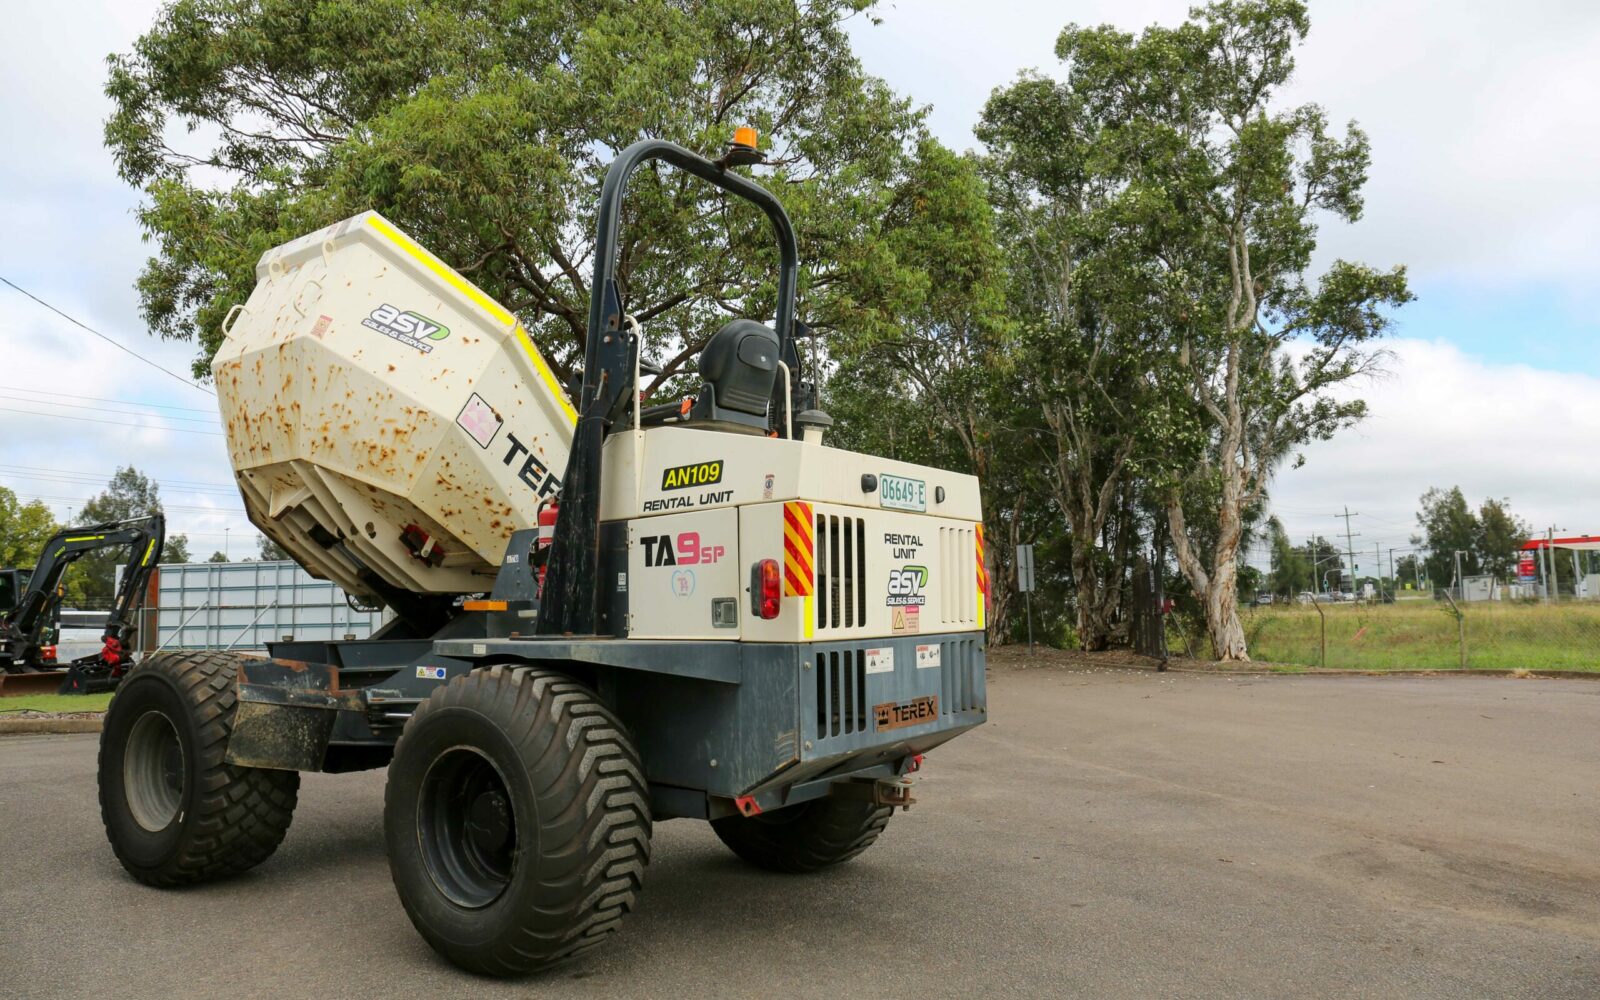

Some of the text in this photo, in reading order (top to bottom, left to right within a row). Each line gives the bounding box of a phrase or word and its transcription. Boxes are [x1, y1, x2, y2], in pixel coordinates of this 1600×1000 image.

[362, 318, 392, 336] SALES
[398, 333, 432, 353] SERVICE
[664, 463, 720, 488] AN109
[643, 490, 734, 512] RENTAL UNIT
[884, 533, 924, 547] RENTAL
[893, 548, 917, 559] UNIT
[893, 700, 935, 722] TEREX
